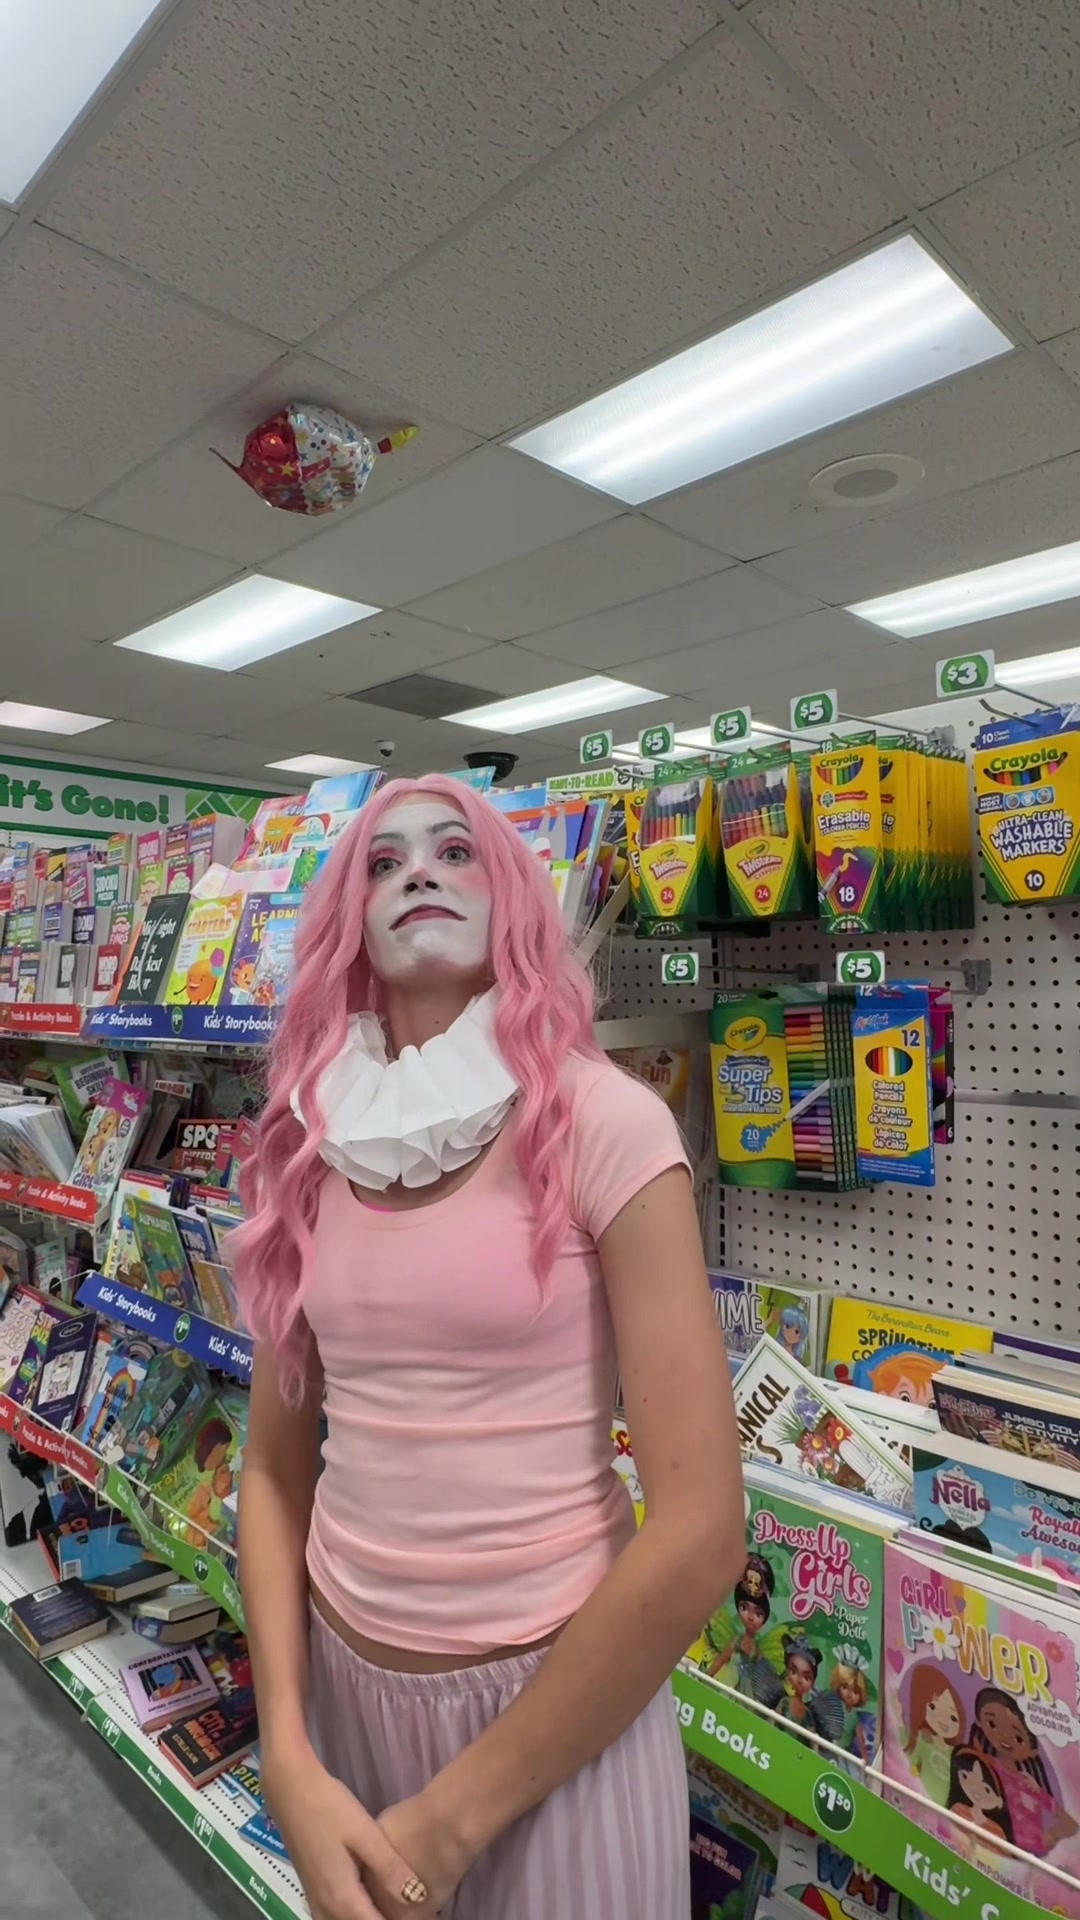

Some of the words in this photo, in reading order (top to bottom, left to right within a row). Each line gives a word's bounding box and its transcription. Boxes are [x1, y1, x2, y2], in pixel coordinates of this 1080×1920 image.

[947, 661, 978, 685] $3
[800, 699, 825, 721] $5
[718, 715, 740, 736] $5
[586, 738, 603, 757] $5
[645, 732, 664, 751] $5
[821, 741, 833, 753] 18
[981, 734, 994, 744] 10
[820, 754, 859, 768] Crayola
[990, 748, 1059, 772] Crayola
[61, 784, 170, 824] Gone!
[817, 810, 870, 828] Erasable
[998, 810, 1063, 830] ULTRA-CLEAN
[990, 821, 1073, 847] WASHABLE
[1001, 839, 1066, 861] MARKERS
[1026, 874, 1043, 887] 10
[662, 891, 673, 899] 24
[756, 890, 769, 899] 24
[839, 886, 855, 902] 18
[669, 959, 689, 977] $5
[847, 957, 872, 978] $5
[717, 994, 728, 1003] 20
[109, 1013, 153, 1029] Storybooks
[203, 1015, 223, 1029] Kids'
[225, 1015, 278, 1033] Storybooks
[901, 1030, 920, 1046] 12
[718, 1066, 772, 1085] Super
[745, 1085, 782, 1105] Tips
[872, 1080, 905, 1091] Colored
[874, 1091, 904, 1102] Pencils
[872, 1104, 907, 1115] Crayons
[745, 1129, 760, 1140] 20
[886, 1140, 909, 1151] Color
[97, 1286, 117, 1302] Kids'
[115, 1294, 157, 1322] Storybooks
[209, 1336, 230, 1356] Kids'
[1001, 1412, 1045, 1429] JUMBO
[1049, 1423, 1080, 1438] COL
[1015, 1424, 1079, 1446] ACTIVITY
[930, 1477, 991, 1512] Nella
[791, 1551, 871, 1619] Girls
[835, 1607, 868, 1626] Paper
[838, 1622, 867, 1640] Dolls
[1029, 1715, 1072, 1736] COLORING
[701, 1708, 771, 1770] Books
[904, 1843, 971, 1906] Kids'
[249, 1875, 267, 1901] Books
